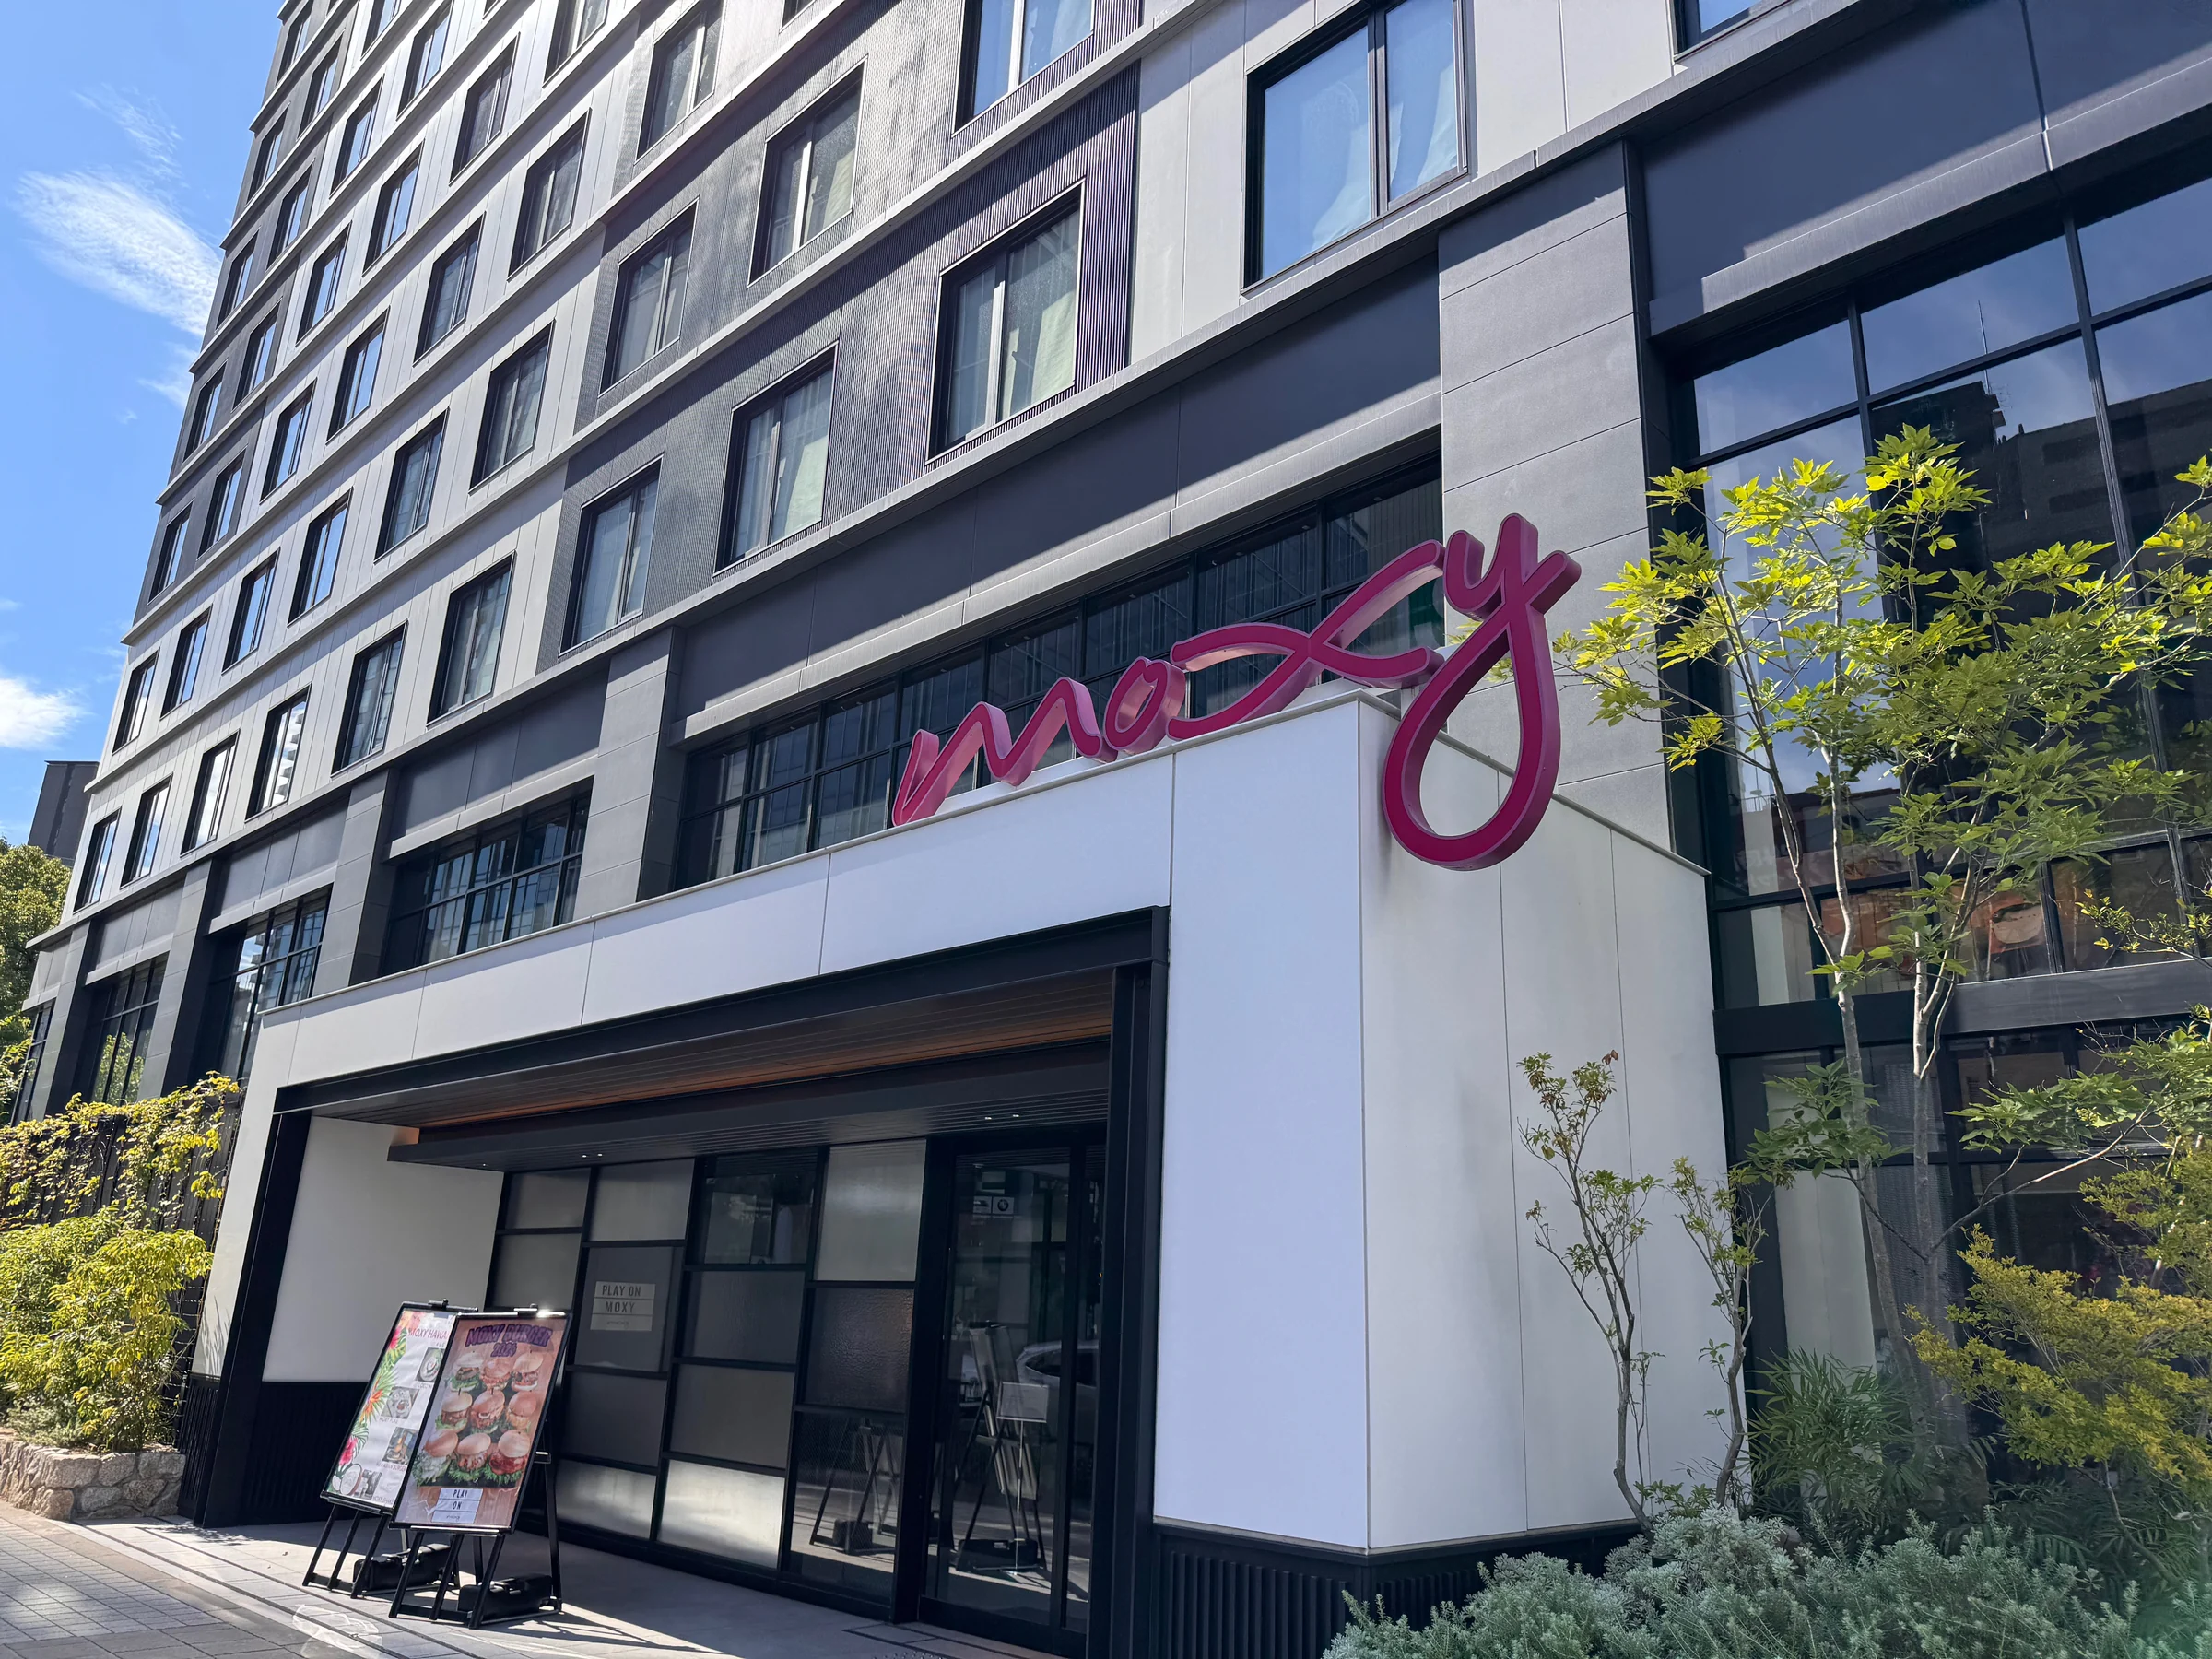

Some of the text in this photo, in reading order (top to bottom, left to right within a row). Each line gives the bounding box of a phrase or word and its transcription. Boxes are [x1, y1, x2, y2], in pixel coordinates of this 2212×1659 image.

[892, 513, 1582, 872] moxy
[602, 1285, 641, 1297] PLAY ON
[605, 1300, 635, 1313] MOXY
[408, 1327, 429, 1339] MOXY
[465, 1324, 553, 1347] MOXY BURGER
[452, 1489, 468, 1499] PLAY
[452, 1500, 463, 1510] ON
